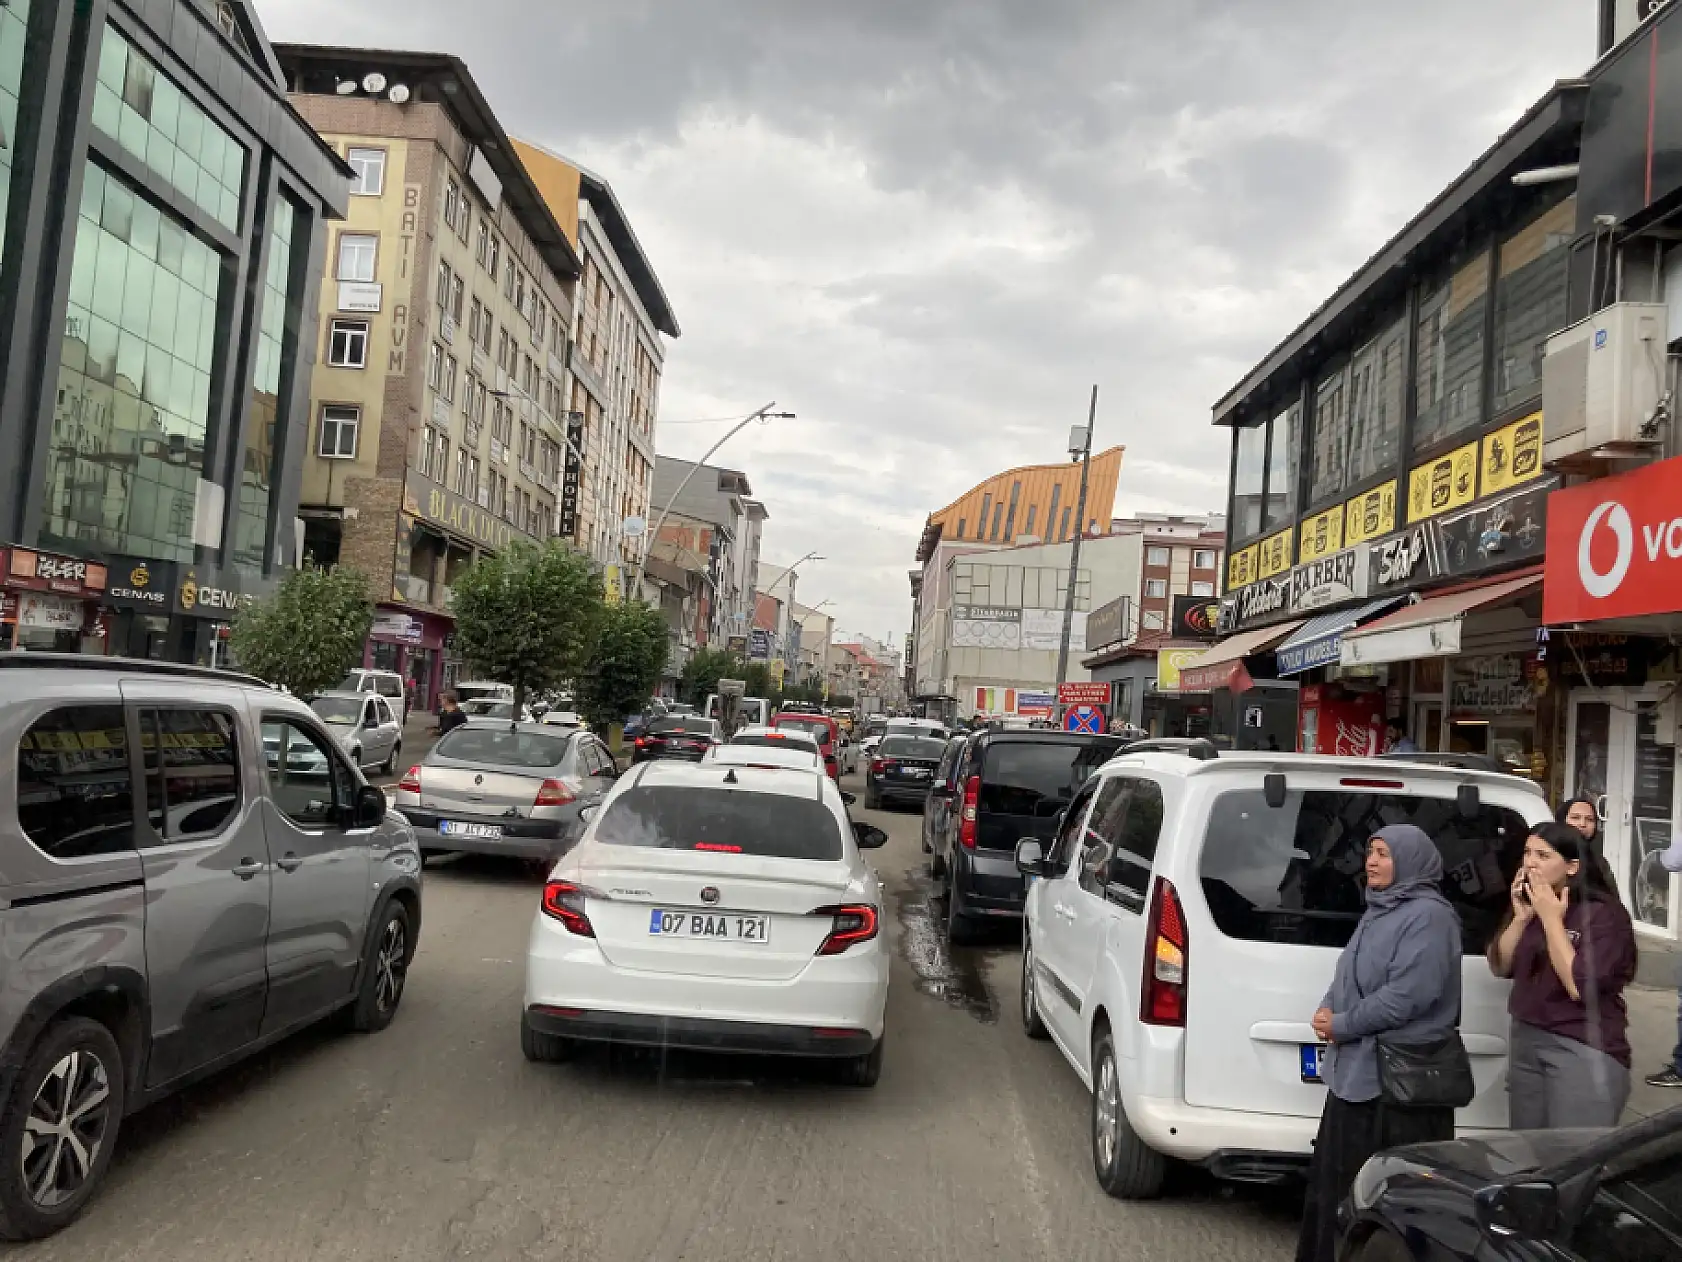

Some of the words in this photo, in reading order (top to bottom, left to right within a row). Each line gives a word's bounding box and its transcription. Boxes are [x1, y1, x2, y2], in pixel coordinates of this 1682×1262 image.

[399, 187, 419, 279] BATI
[388, 304, 407, 371] AVM
[429, 488, 478, 538] BLACK
[111, 588, 165, 603] CENAS
[661, 913, 686, 933] 07
[690, 915, 728, 937] BAA
[736, 919, 765, 939] 121
